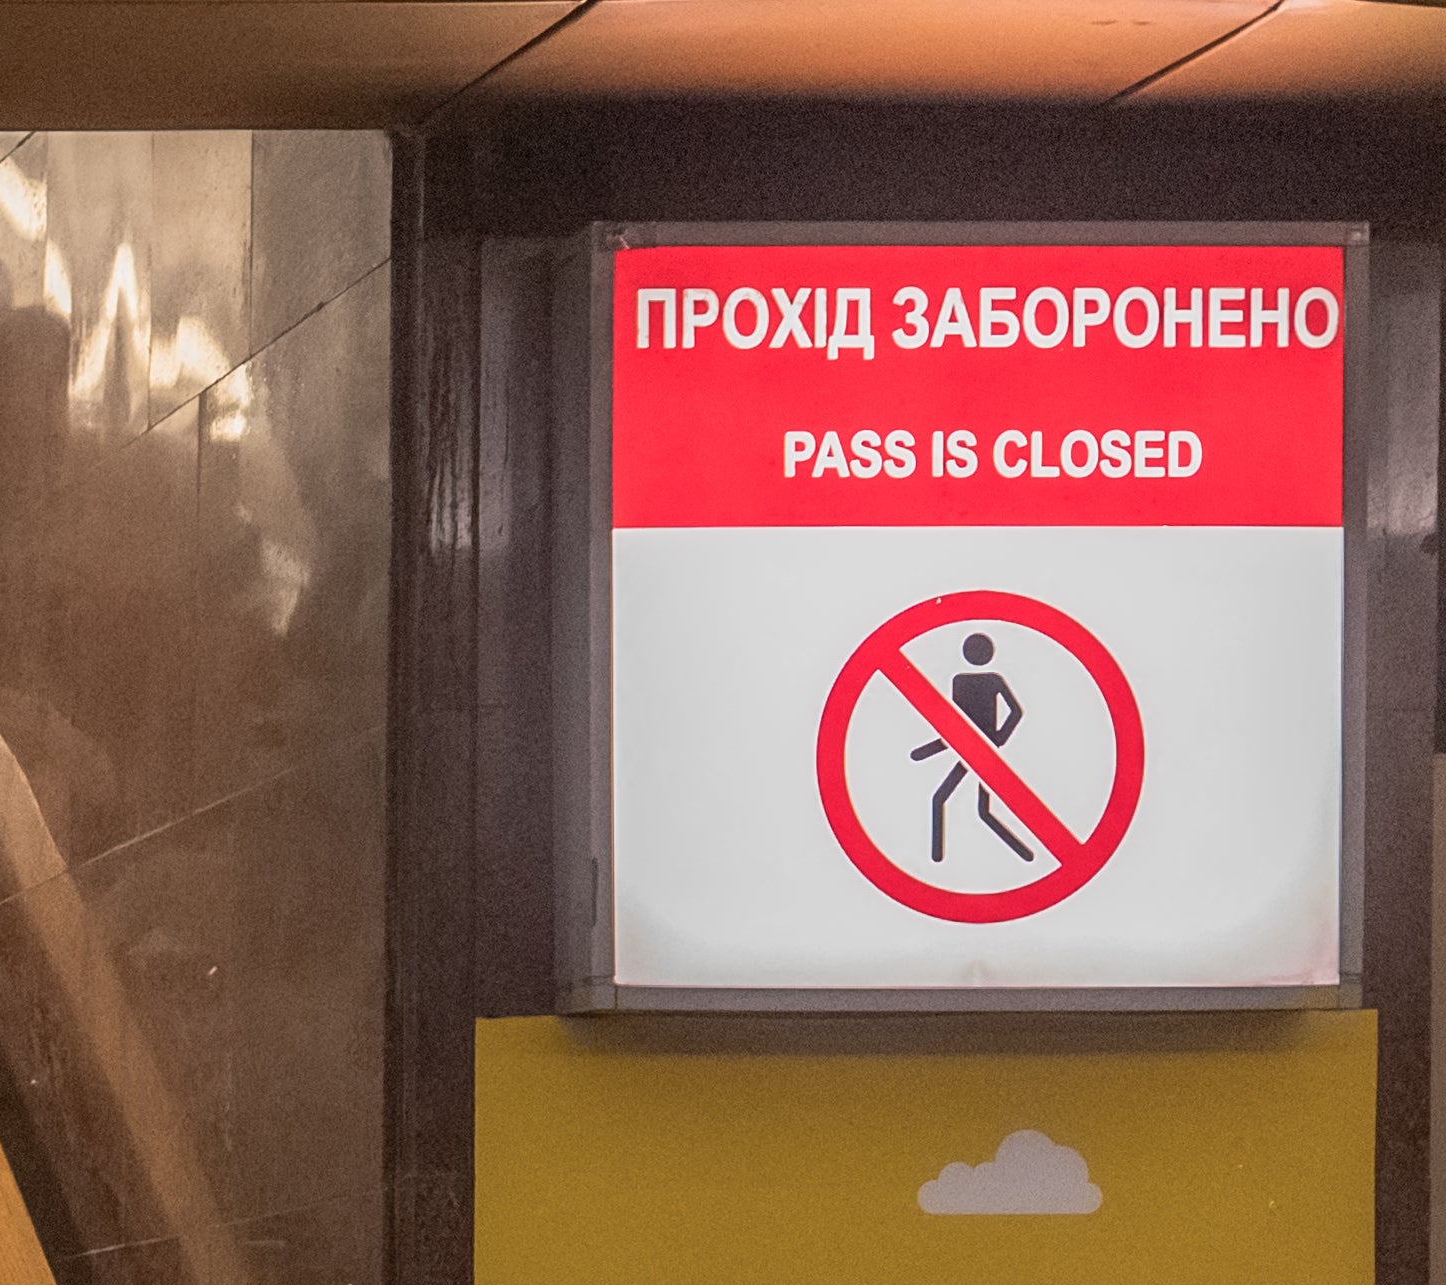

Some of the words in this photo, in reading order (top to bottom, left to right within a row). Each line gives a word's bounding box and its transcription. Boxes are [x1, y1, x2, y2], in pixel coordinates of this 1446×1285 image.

[636, 286, 875, 361] ПРОХІД
[891, 285, 1340, 350] ЗАБОРОНЕНО
[783, 429, 917, 479] PASS
[931, 429, 980, 479] IS
[992, 428, 1204, 479] CLOSED
